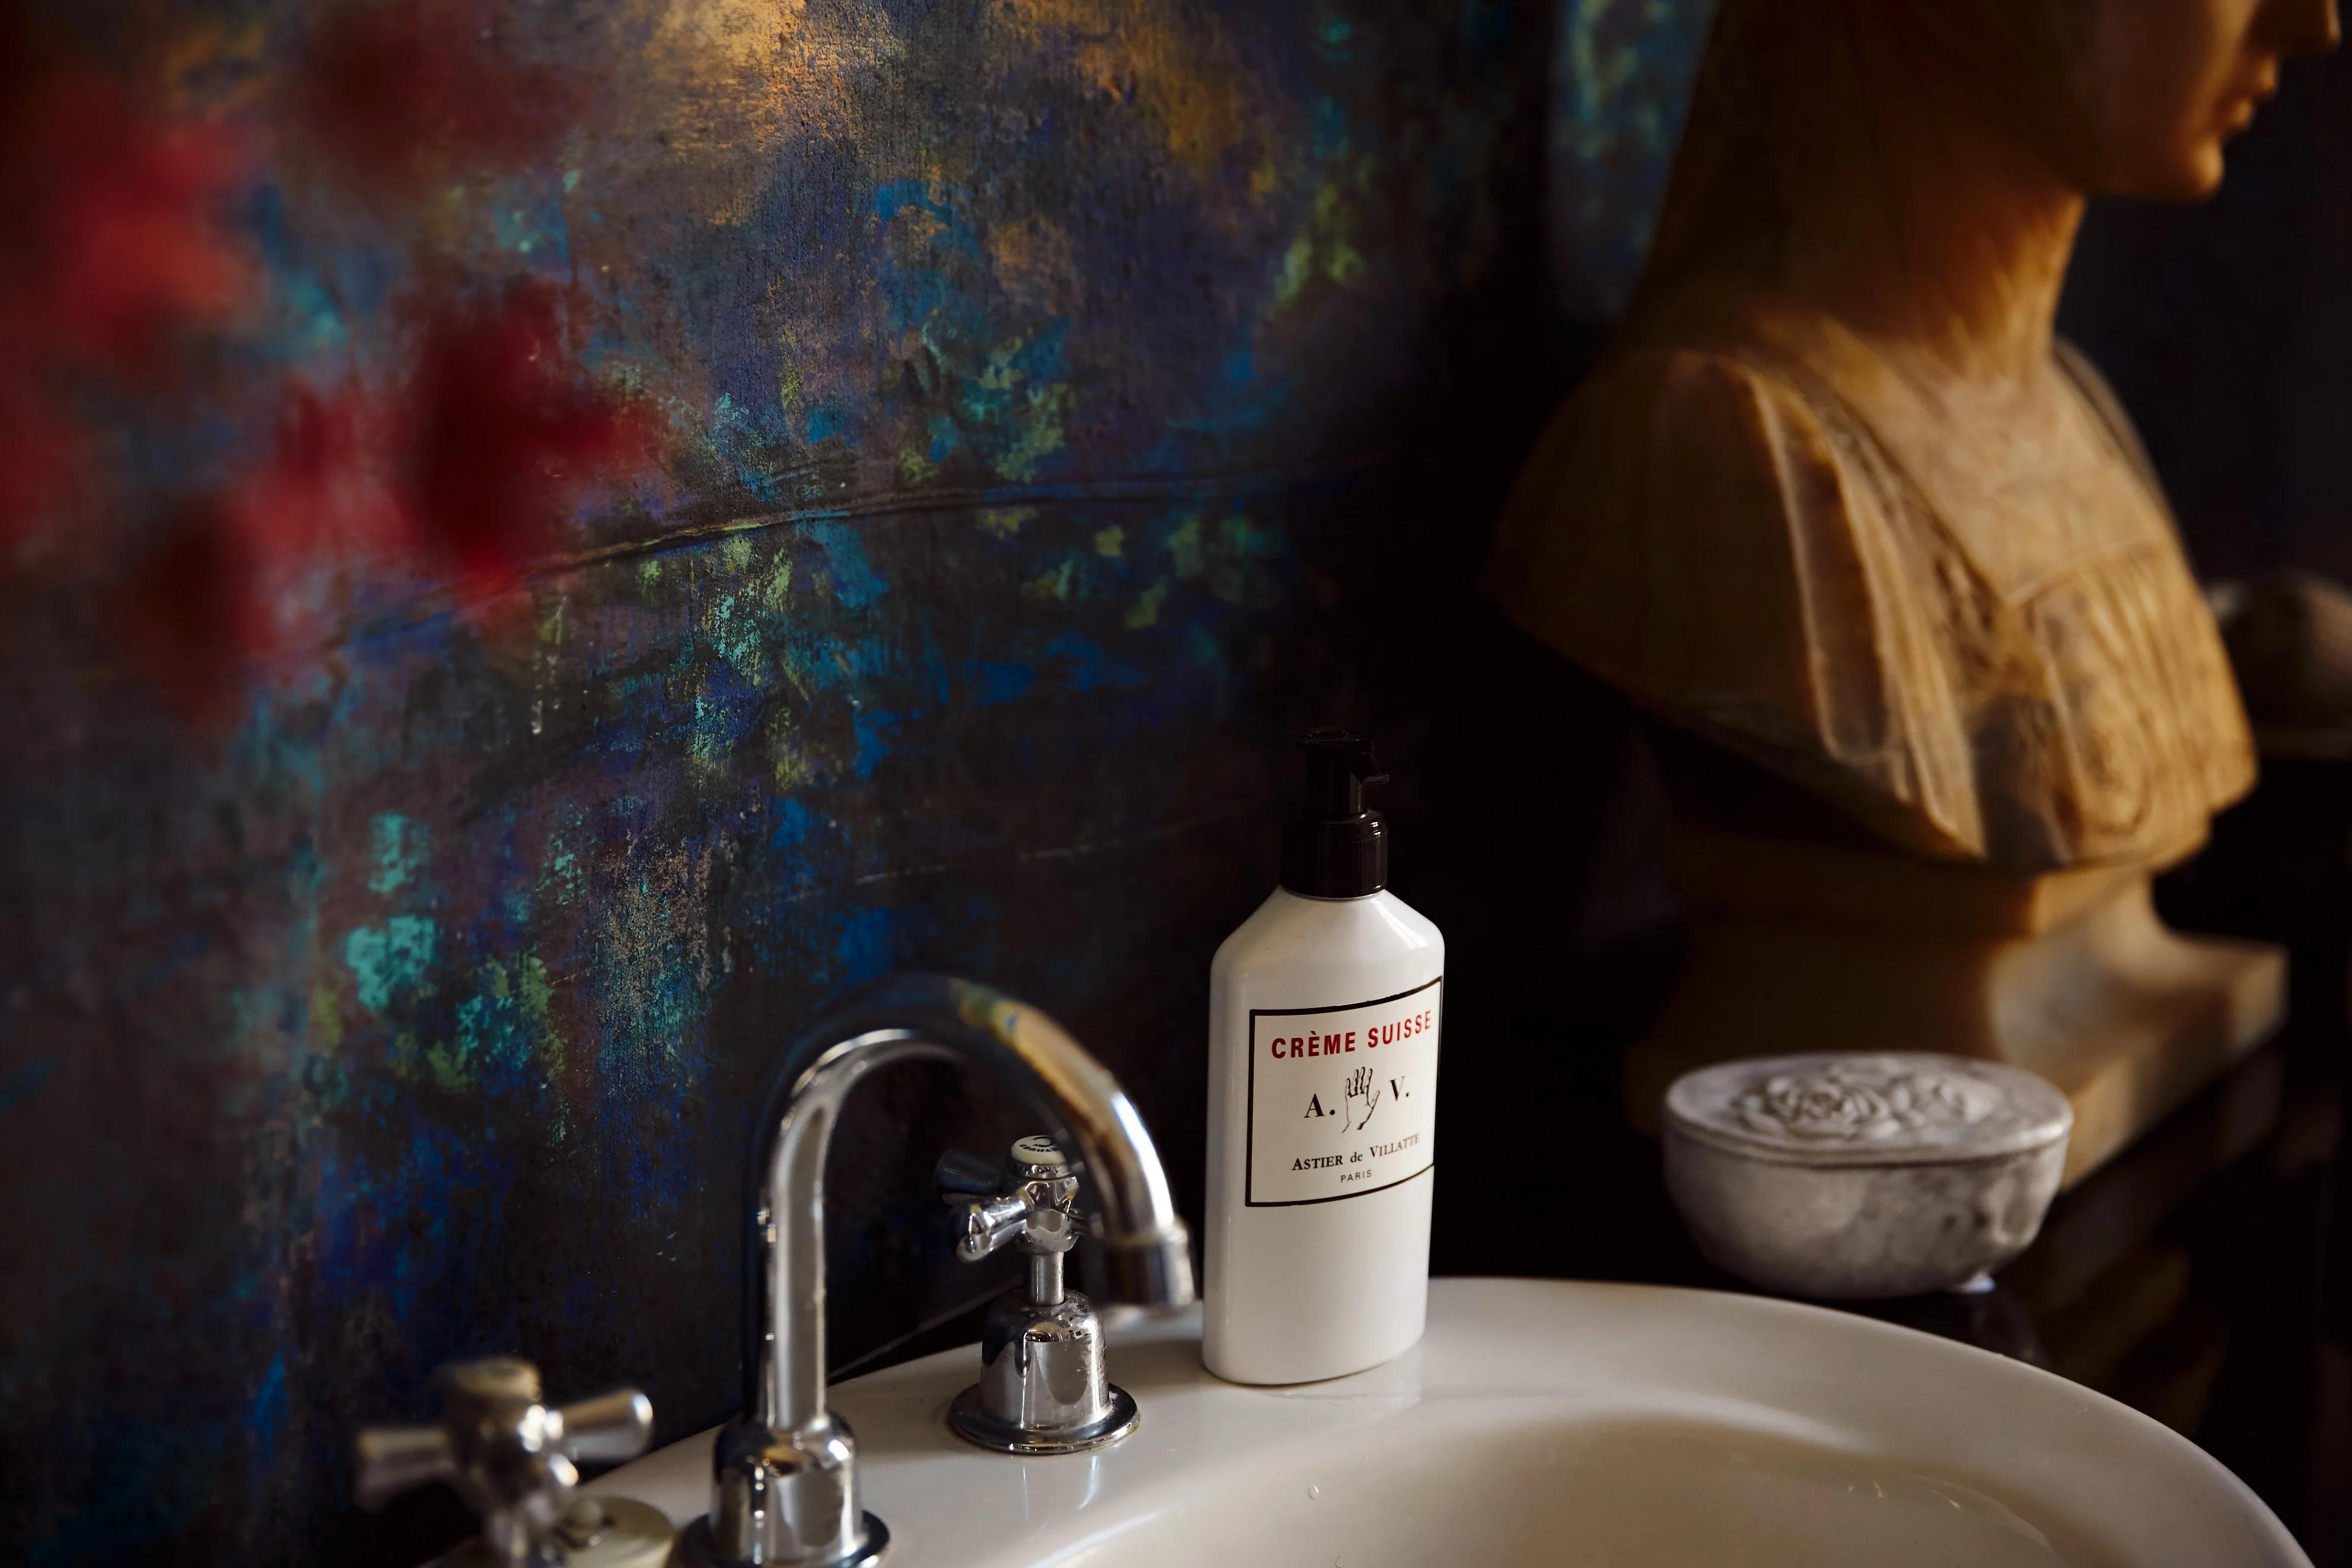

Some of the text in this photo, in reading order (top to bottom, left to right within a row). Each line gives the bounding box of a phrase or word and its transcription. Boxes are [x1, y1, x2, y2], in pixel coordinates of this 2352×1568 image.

[1271, 1010, 1432, 1059] CRÈME SUISSE
[1304, 1076, 1410, 1118] A. V.
[1292, 1133, 1420, 1171] ASTIER de VILLATTE
[1340, 1169, 1373, 1183] PARIS
